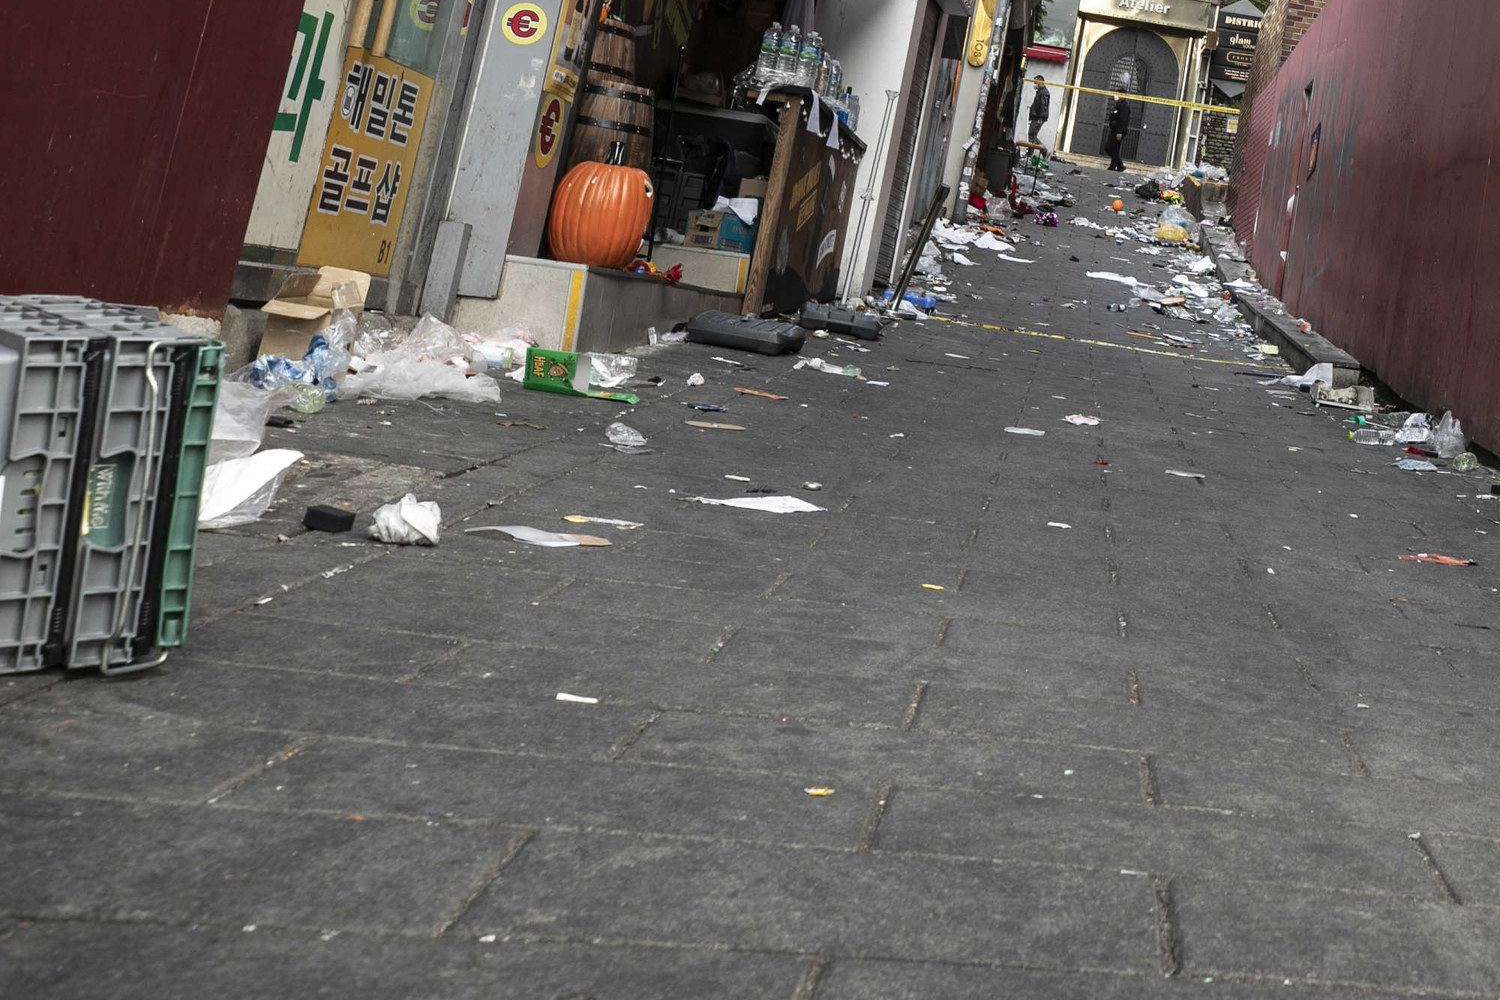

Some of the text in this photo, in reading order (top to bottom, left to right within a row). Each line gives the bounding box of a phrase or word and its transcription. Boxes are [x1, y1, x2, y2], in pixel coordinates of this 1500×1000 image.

[1229, 33, 1251, 46] glam
[341, 60, 419, 148] 해밀톤
[316, 143, 402, 227] 골프샵
[377, 239, 392, 265] B1
[533, 355, 546, 379] HBAF
